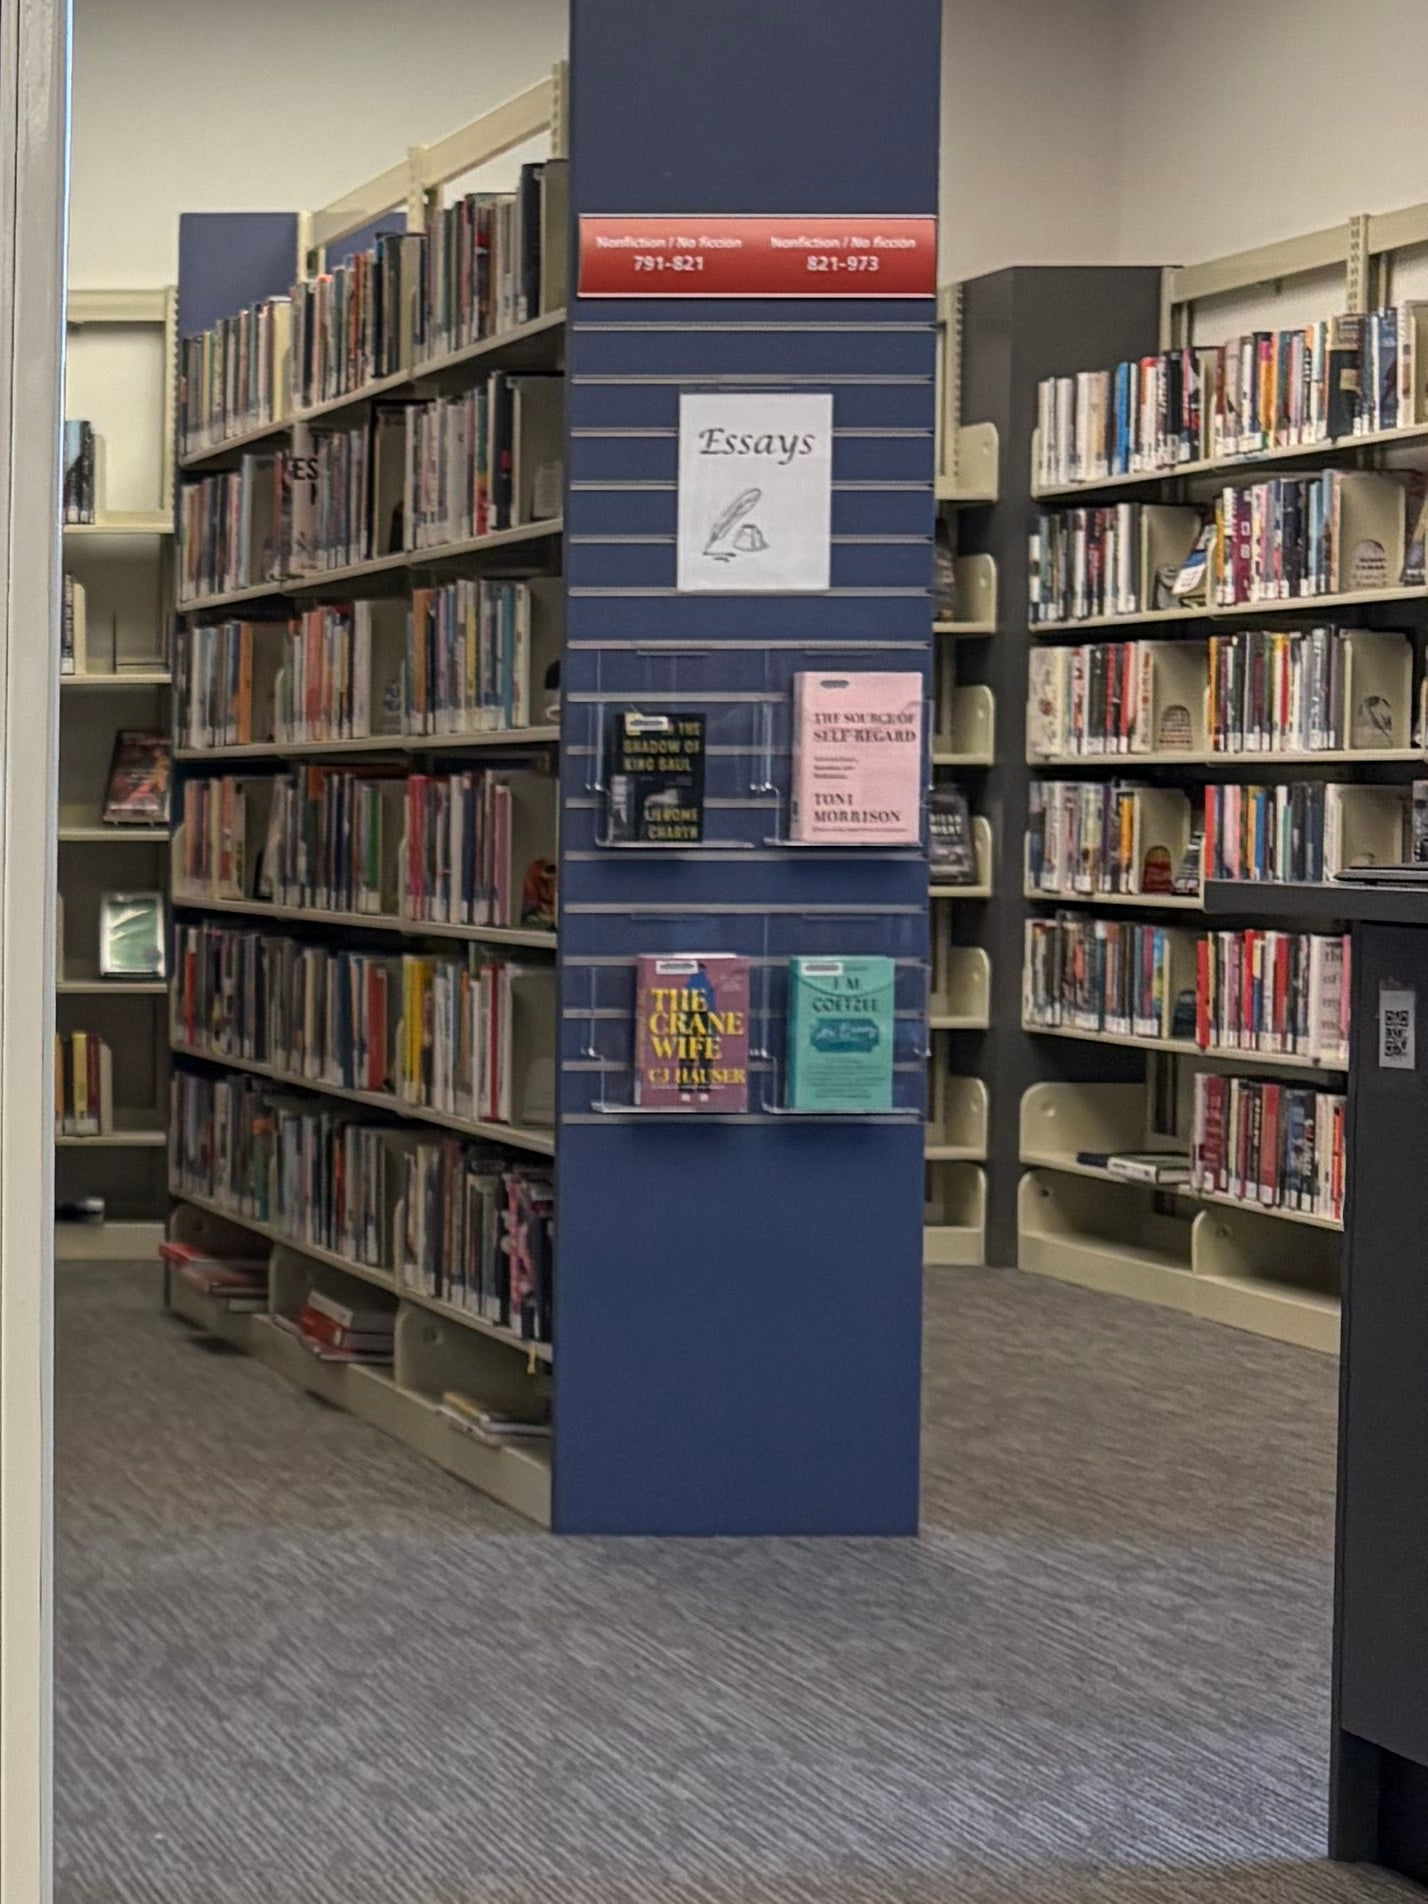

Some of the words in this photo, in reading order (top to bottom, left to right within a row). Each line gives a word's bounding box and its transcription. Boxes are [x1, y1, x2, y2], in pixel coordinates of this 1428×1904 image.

[697, 426, 816, 466] Essays
[812, 728, 916, 744] SELF-REGARD
[813, 792, 853, 808] TONI
[812, 809, 902, 824] MORRISON
[651, 987, 706, 1011] THE
[648, 1012, 744, 1036] CRANE
[652, 1036, 722, 1060] WIFE
[672, 1067, 745, 1085] HAUSER
